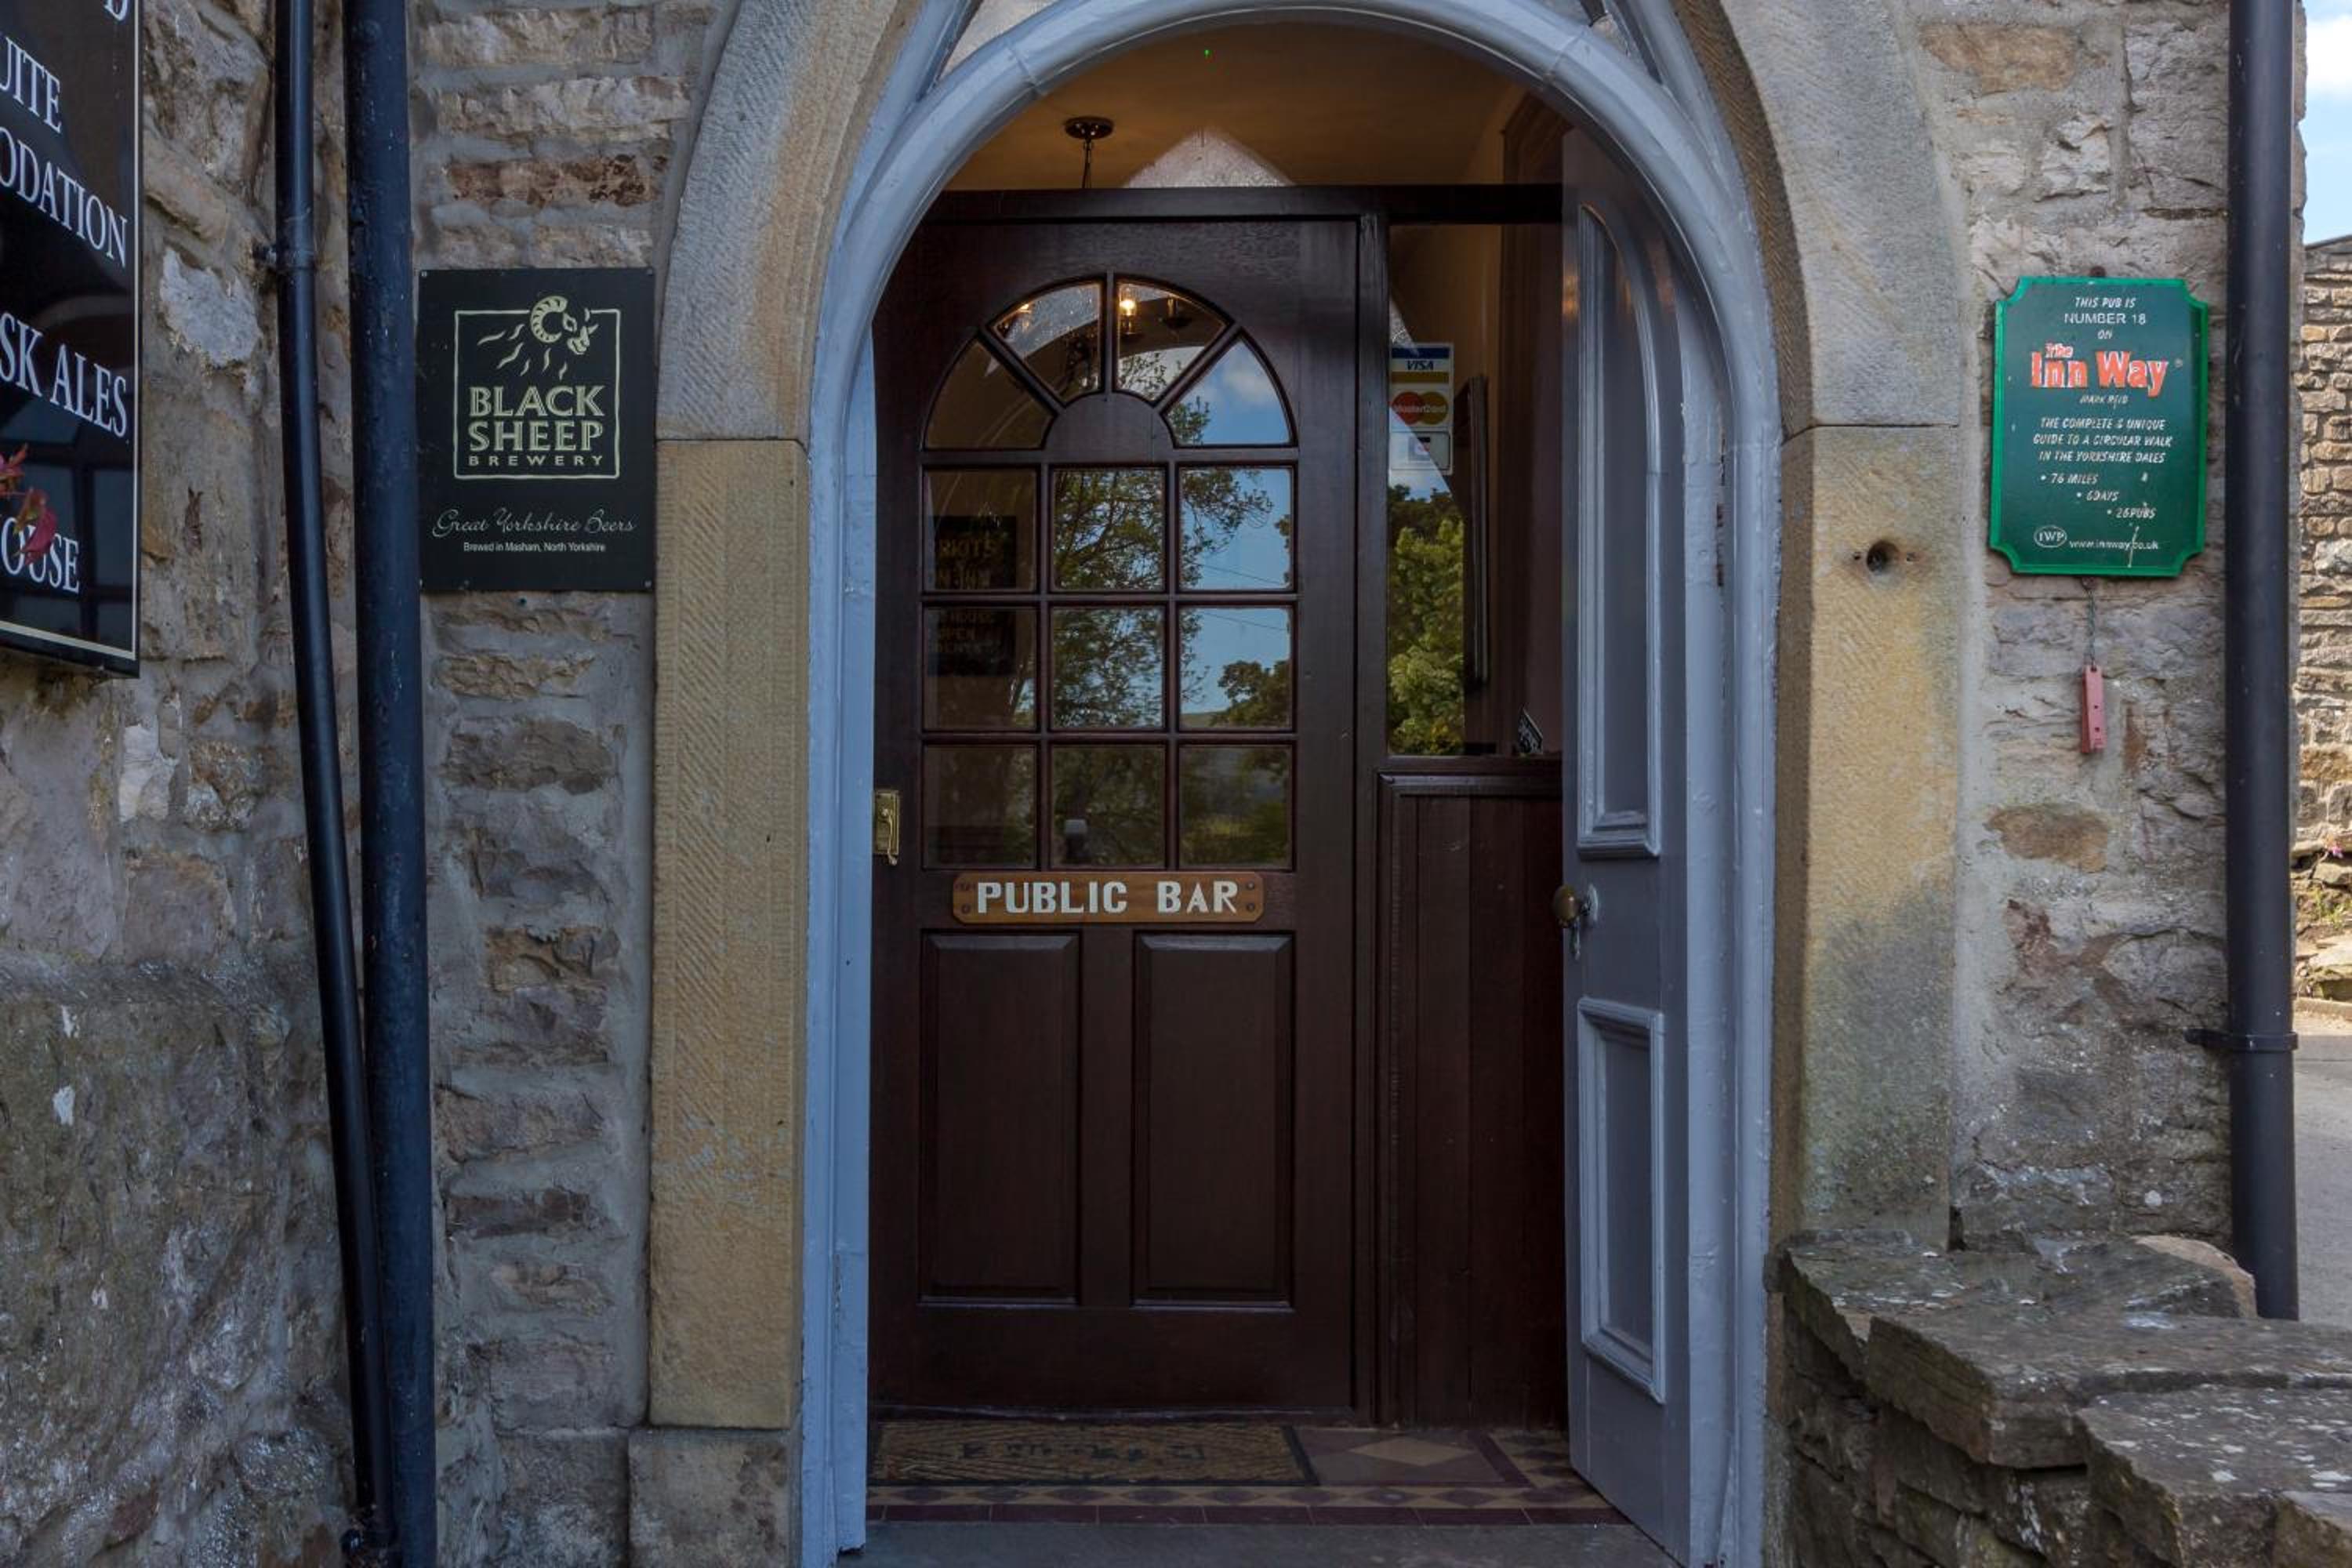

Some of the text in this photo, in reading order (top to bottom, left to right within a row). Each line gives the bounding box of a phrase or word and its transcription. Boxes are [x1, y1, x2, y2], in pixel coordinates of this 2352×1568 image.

[0, 126, 128, 269] ODATION
[2075, 297, 2136, 308] THIS PUB IS
[2064, 314, 2146, 325] NUMBER 18
[2097, 329, 2113, 339] ON
[2045, 343, 2073, 358] The
[1406, 361, 1434, 370] VISA
[0, 311, 127, 437] SK ALES
[2031, 350, 2169, 397] Inn Way
[470, 386, 605, 416] BLACK
[2041, 417, 2058, 429] THE
[2062, 417, 2112, 430] COMPLETE
[2126, 419, 2166, 430] UNIQUE
[468, 420, 603, 452] SHEEP
[2033, 434, 2172, 447] GUIDE TO A CIRCULAR WALK
[470, 455, 604, 466] BREWERY
[2039, 451, 2166, 463] IN THE YORKSHIRE DALES
[2051, 474, 2098, 485] 76 MILES
[433, 508, 637, 538] Great Yorkshire Beers
[2039, 531, 2064, 542] IWP
[463, 542, 606, 553] Brewed in Masham, North Yorkshire
[978, 880, 1239, 913] PUBLIC BAR
